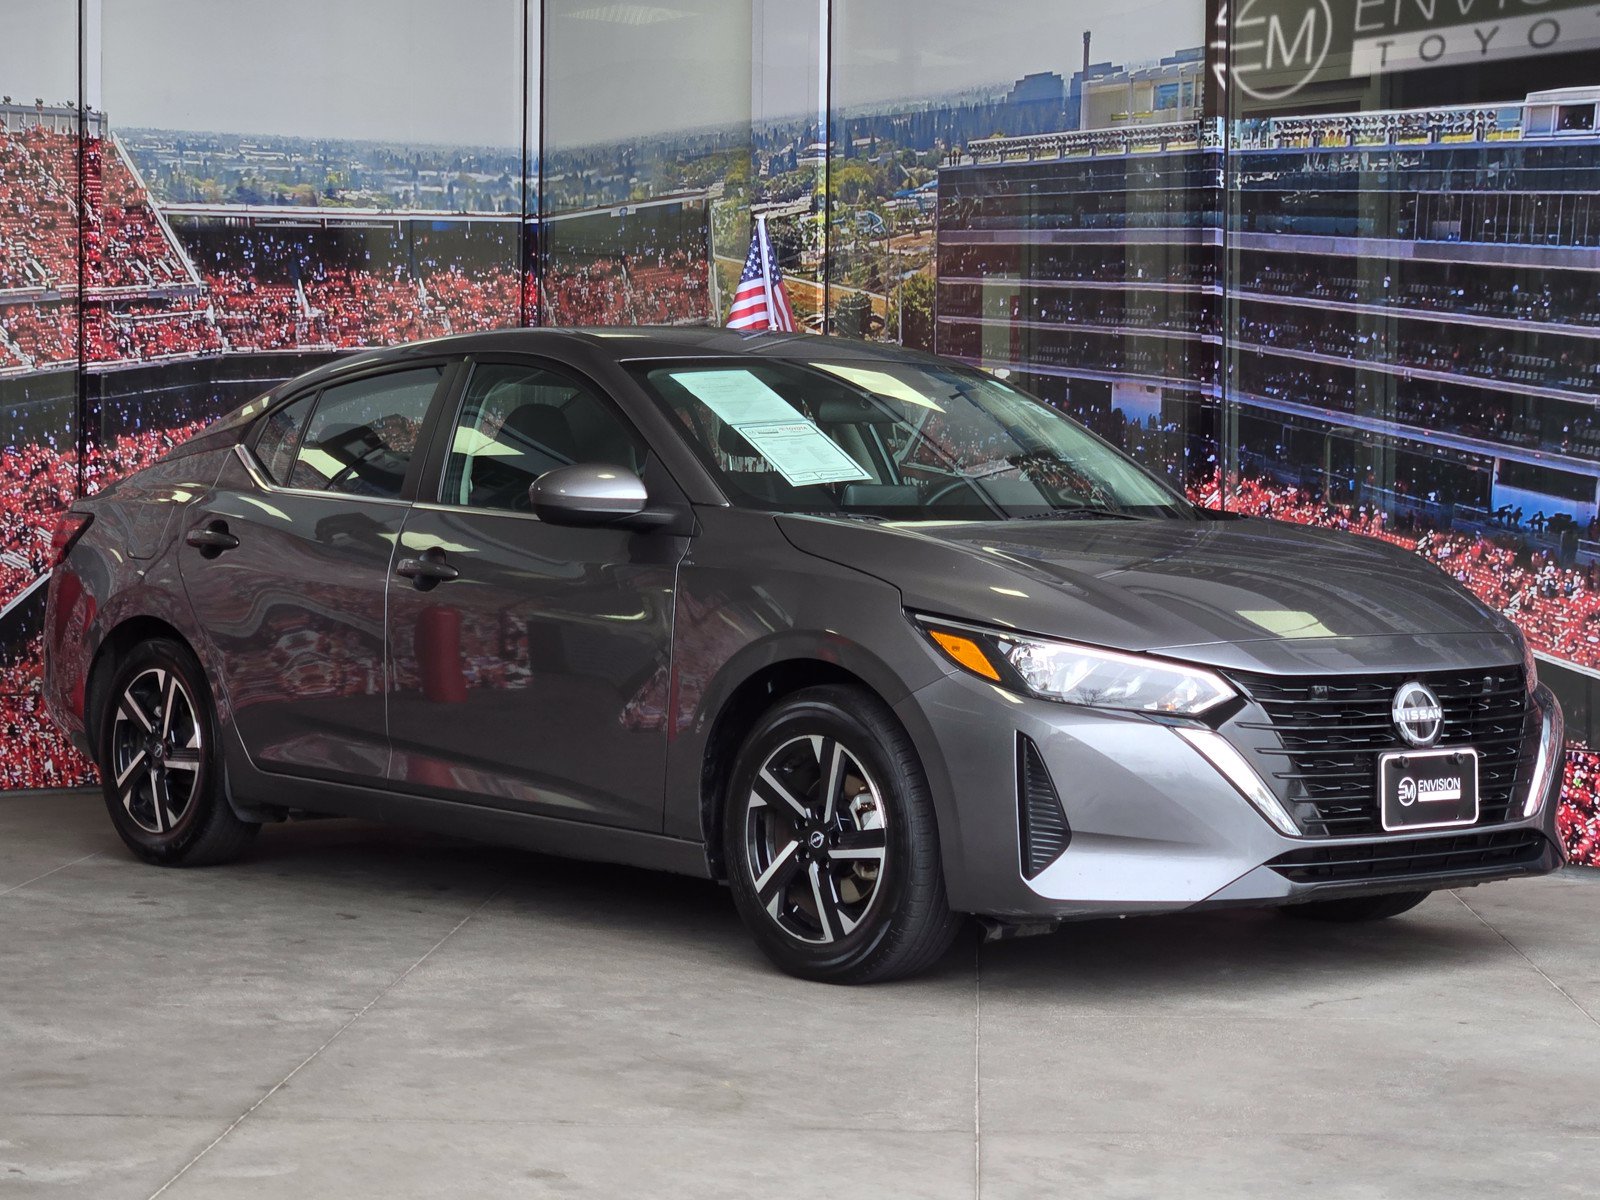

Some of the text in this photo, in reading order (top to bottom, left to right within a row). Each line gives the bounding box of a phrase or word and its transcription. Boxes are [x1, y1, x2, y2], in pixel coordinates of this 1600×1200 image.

[1376, 12, 1600, 67] TOYO
[1395, 708, 1442, 721] NISSAN
[1417, 777, 1461, 793] ENVISION
